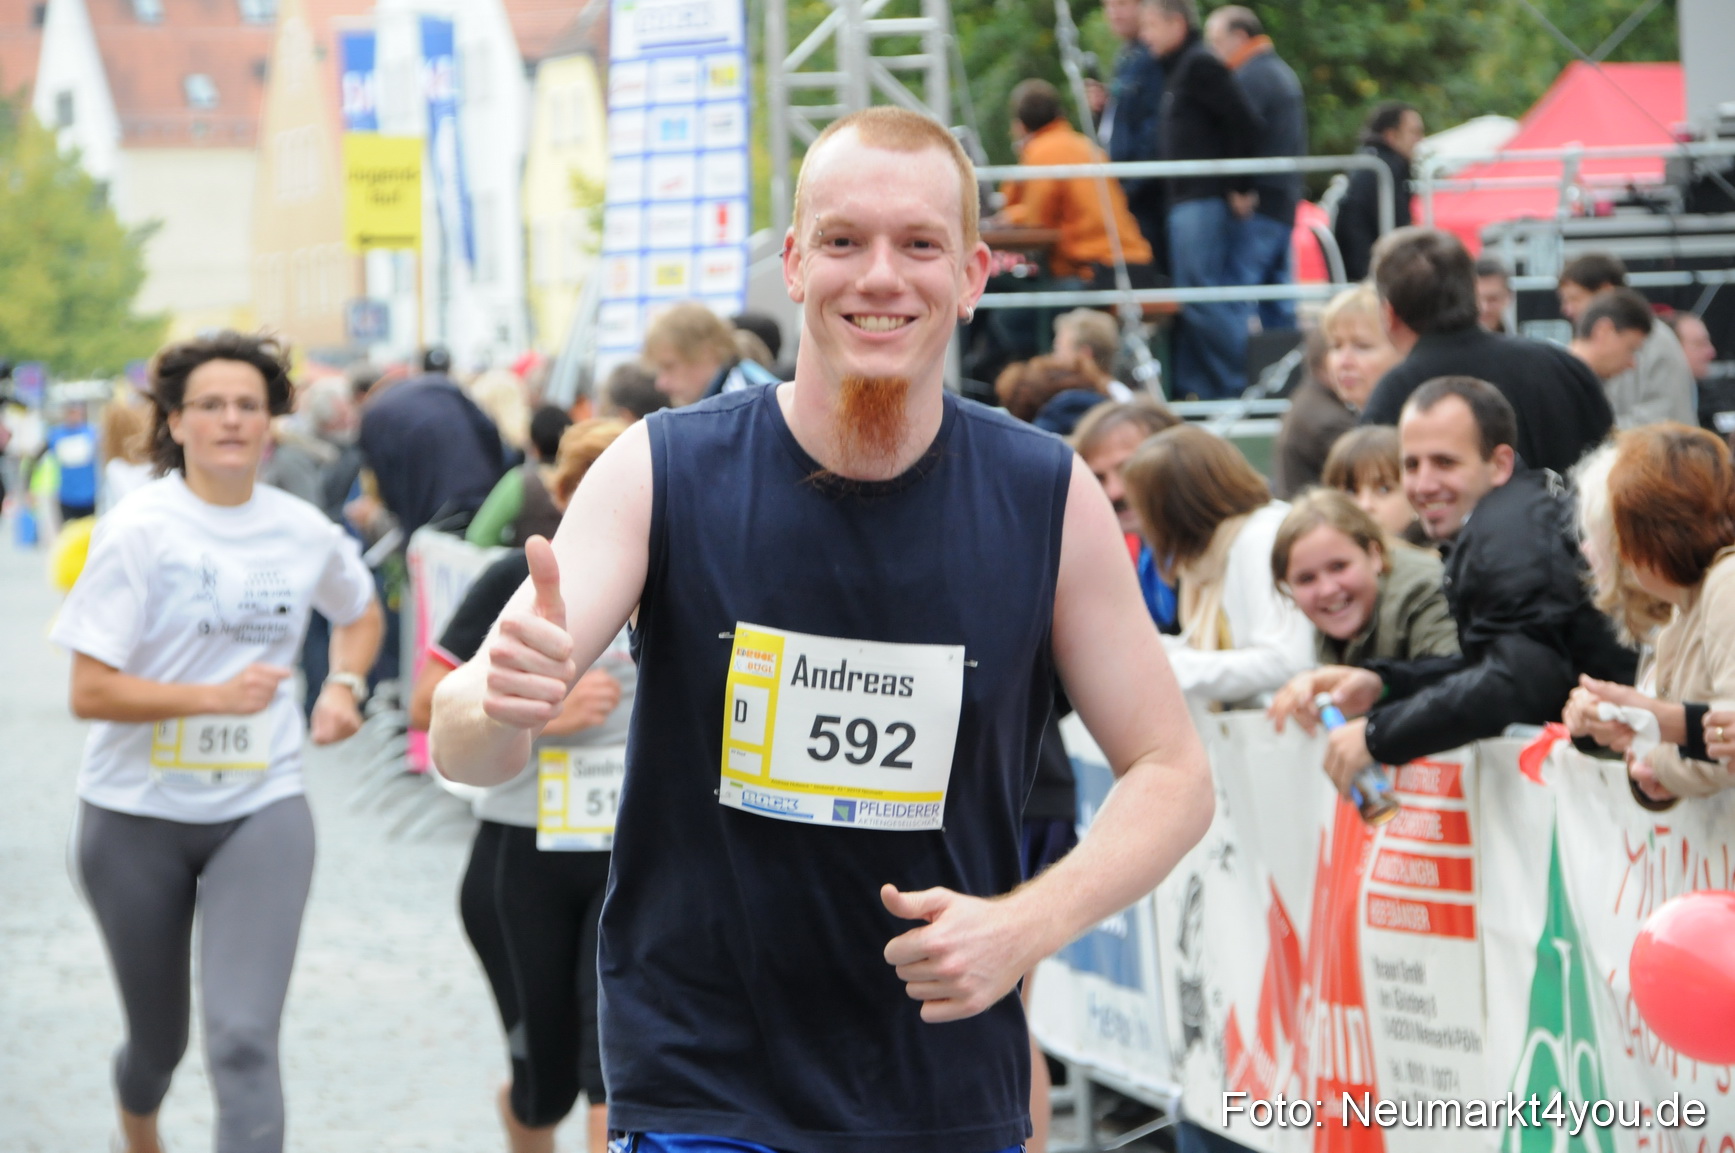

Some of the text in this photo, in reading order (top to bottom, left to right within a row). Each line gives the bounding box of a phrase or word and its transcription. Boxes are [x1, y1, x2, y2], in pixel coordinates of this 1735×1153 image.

[790, 653, 914, 698] Andreas
[734, 699, 748, 723] D
[198, 725, 249, 754] 516
[806, 713, 917, 770] 592
[586, 788, 619, 816] 51
[858, 801, 940, 819] PFLEIDERER
